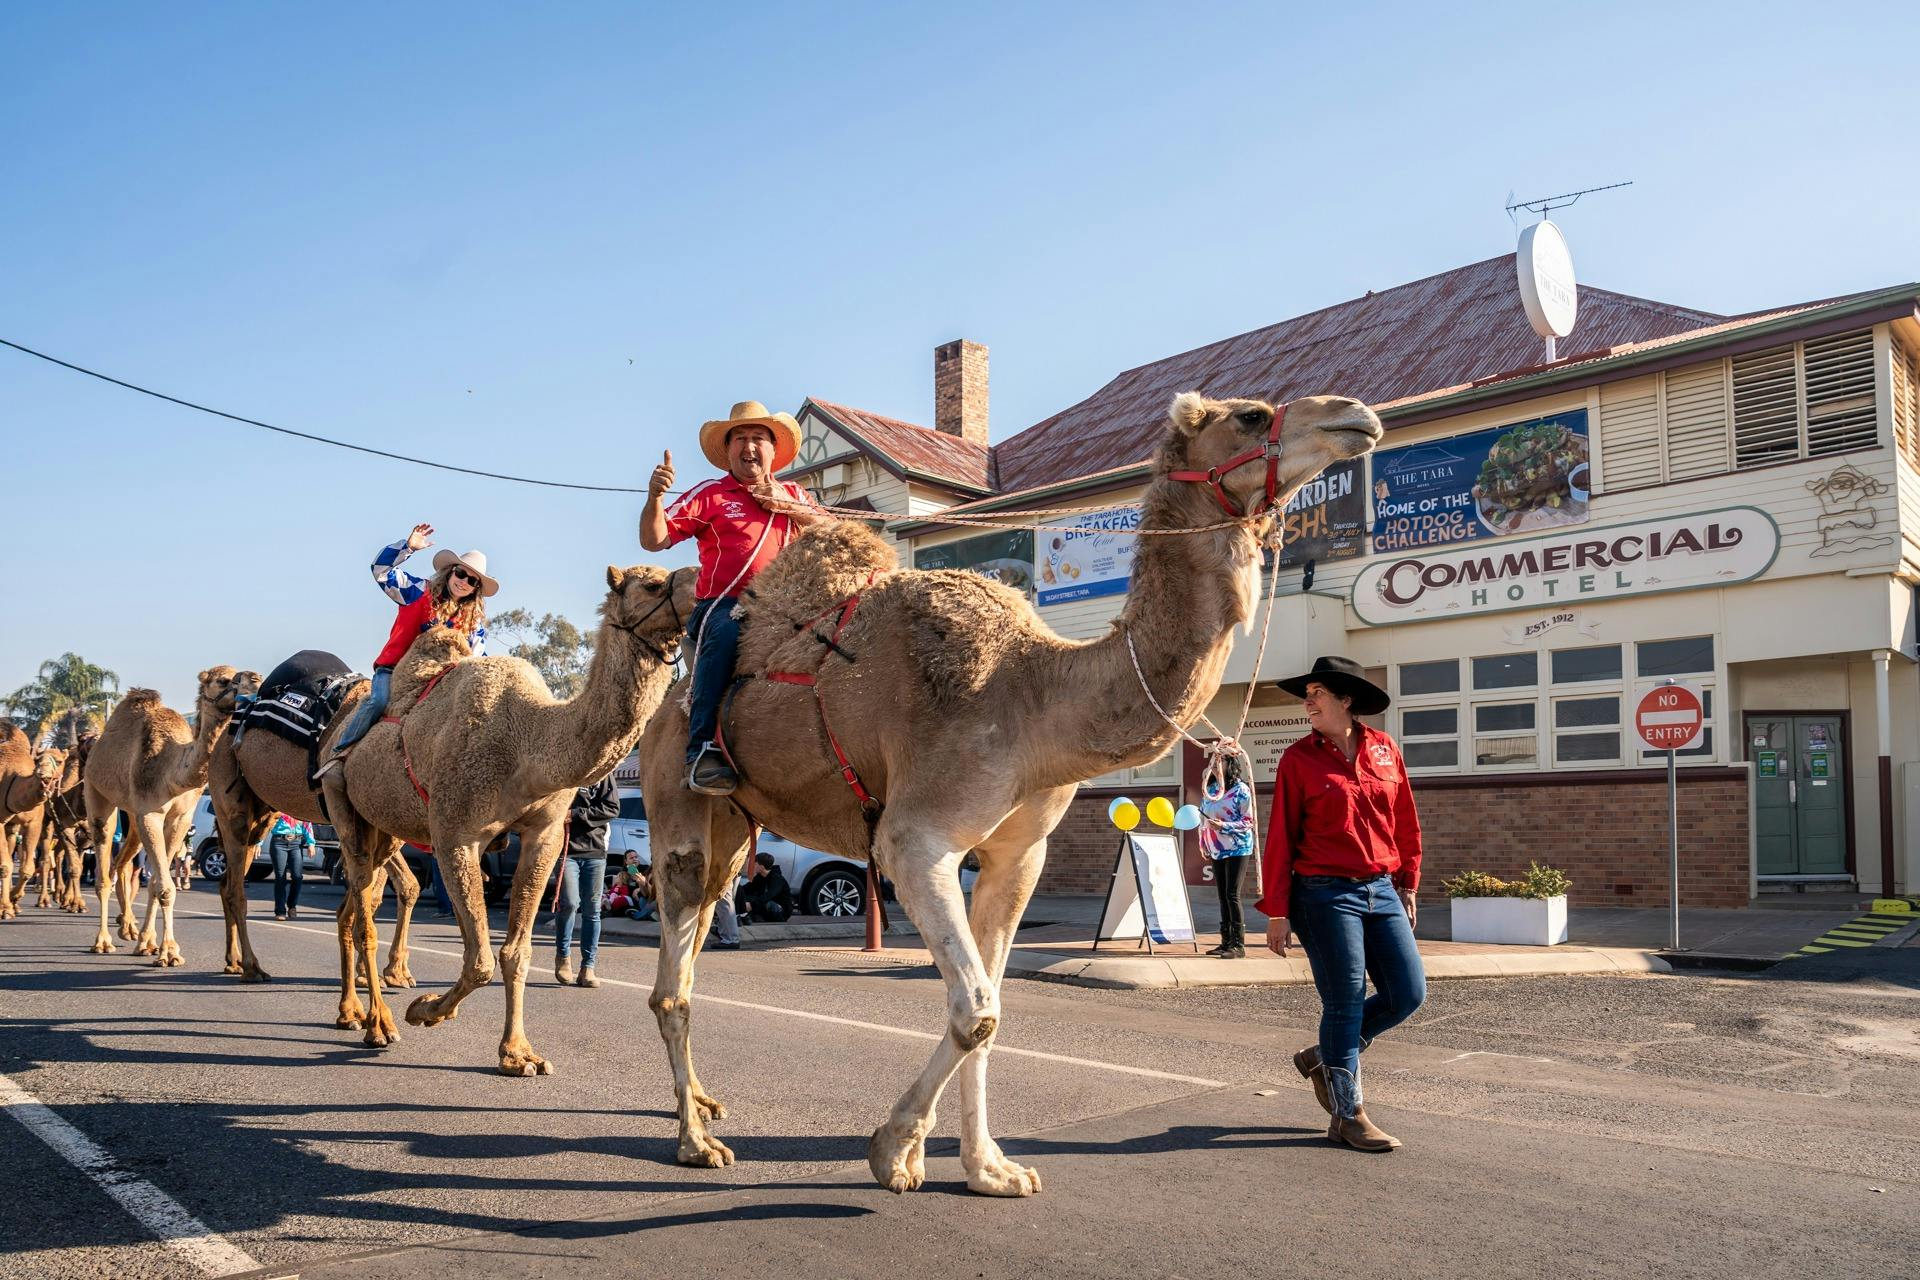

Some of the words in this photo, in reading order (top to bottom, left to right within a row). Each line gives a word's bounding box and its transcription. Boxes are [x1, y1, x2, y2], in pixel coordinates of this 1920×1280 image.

[1394, 473, 1417, 486] THE
[1421, 466, 1454, 481] TARA
[1284, 470, 1353, 513] ARDEN
[1080, 514, 1093, 523] THE
[1093, 511, 1112, 521] TARA
[1112, 507, 1134, 518] HOTEL
[1378, 501, 1416, 519] HOME
[1420, 498, 1439, 512] OF
[1443, 492, 1471, 509] THE
[1065, 513, 1140, 541] BREAKFAS
[1285, 504, 1329, 544] SH!
[1385, 510, 1465, 534] HOTDOG
[1374, 521, 1477, 550] CHALLENGE
[1381, 523, 1743, 605] COMMERCIAL
[1471, 571, 1633, 606] HOTEL
[1525, 619, 1550, 636] EST.
[1551, 613, 1575, 624] 1912
[1658, 694, 1678, 707] NO
[1243, 717, 1313, 729] ACCOMMODATIO
[1646, 726, 1692, 741] ENTRY
[1254, 737, 1302, 746] SELF-CONTAIN
